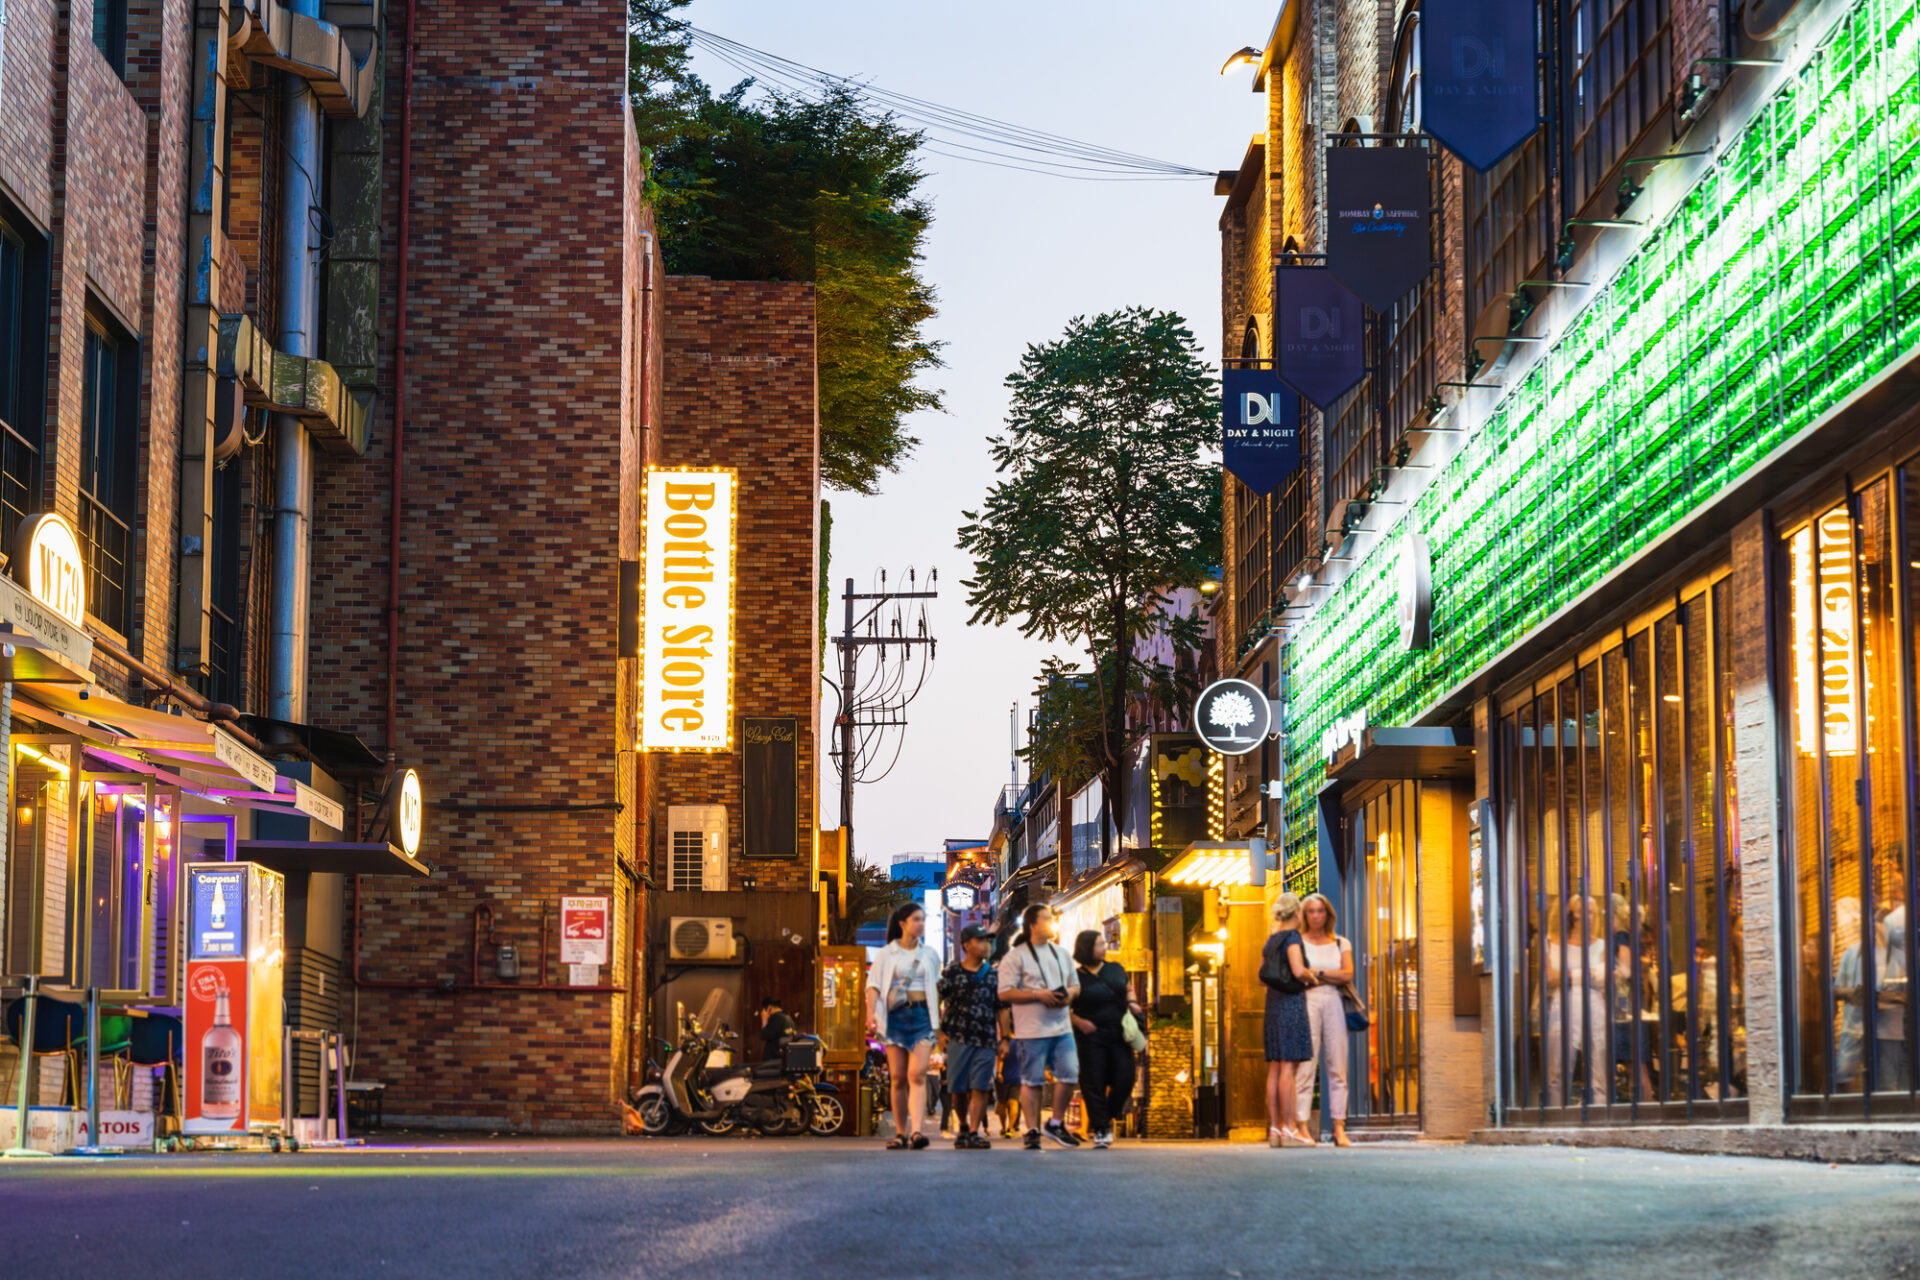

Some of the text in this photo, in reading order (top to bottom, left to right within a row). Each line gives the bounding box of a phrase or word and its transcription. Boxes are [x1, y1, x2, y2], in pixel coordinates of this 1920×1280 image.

[1339, 210, 1371, 218] BOMBAY
[1287, 344, 1308, 352] DAY
[1324, 344, 1355, 352] NIGHT
[1227, 429, 1295, 437] DAY & NIGHT
[40, 543, 79, 622] W179
[660, 481, 716, 732] Bottle Store
[24, 606, 59, 642] LIQUOR STORE
[198, 874, 240, 884] Corona!
[207, 1048, 236, 1058] Tito's
